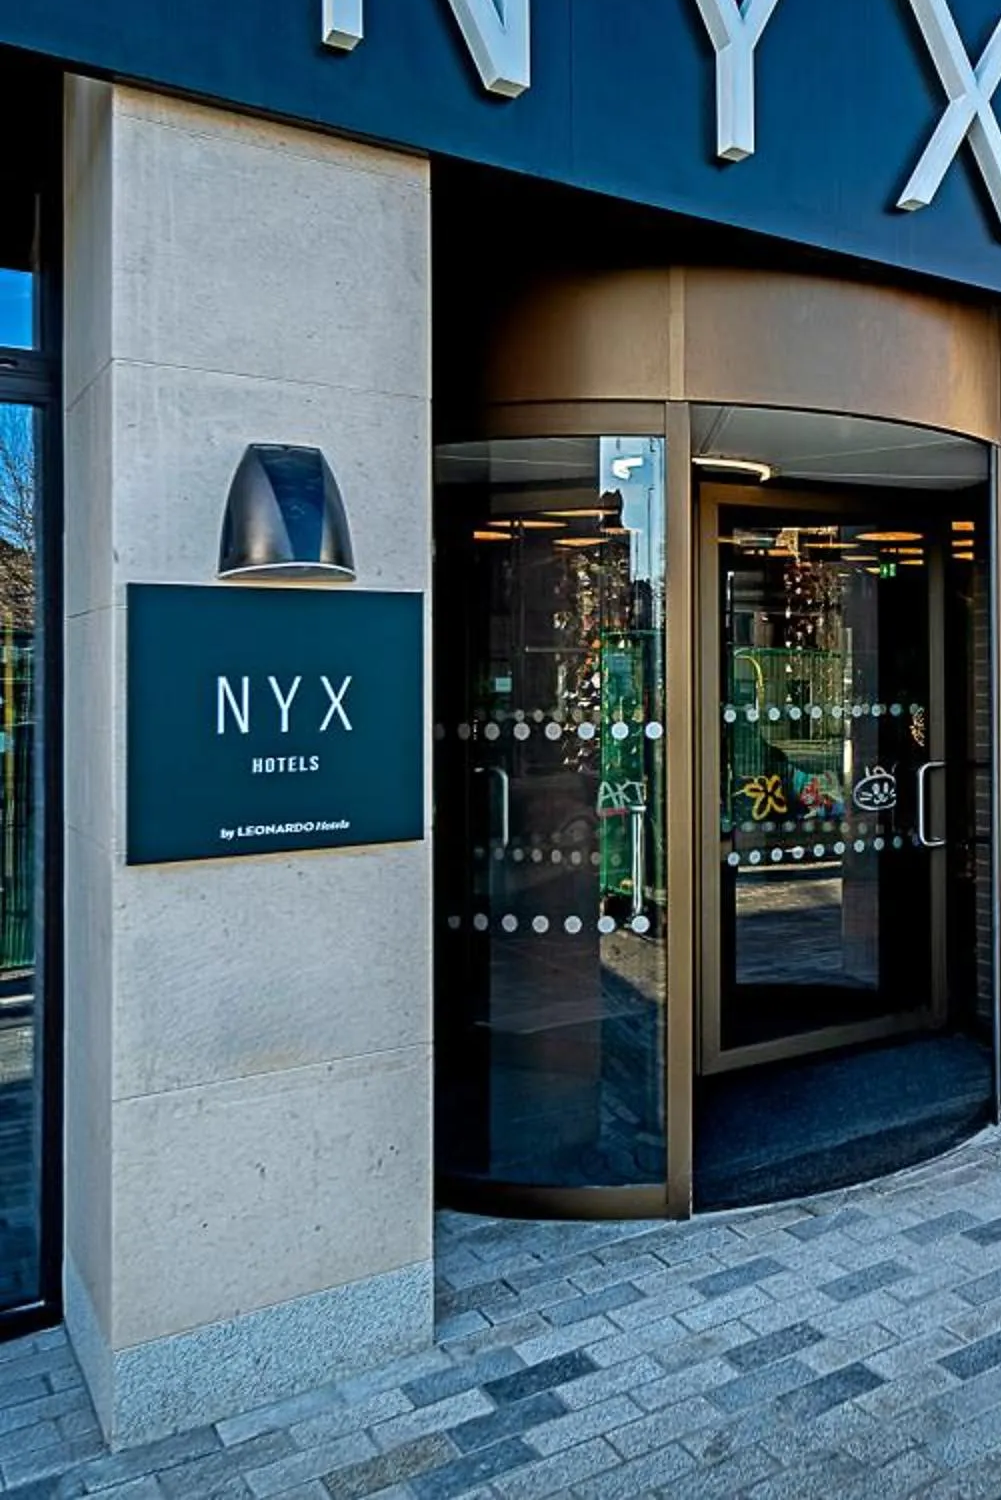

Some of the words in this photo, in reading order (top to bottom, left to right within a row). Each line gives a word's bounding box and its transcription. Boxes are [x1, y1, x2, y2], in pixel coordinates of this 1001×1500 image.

[217, 676, 352, 734] NYX
[252, 756, 319, 773] HOTELS
[220, 828, 235, 840] by
[237, 822, 314, 836] LEONARDO
